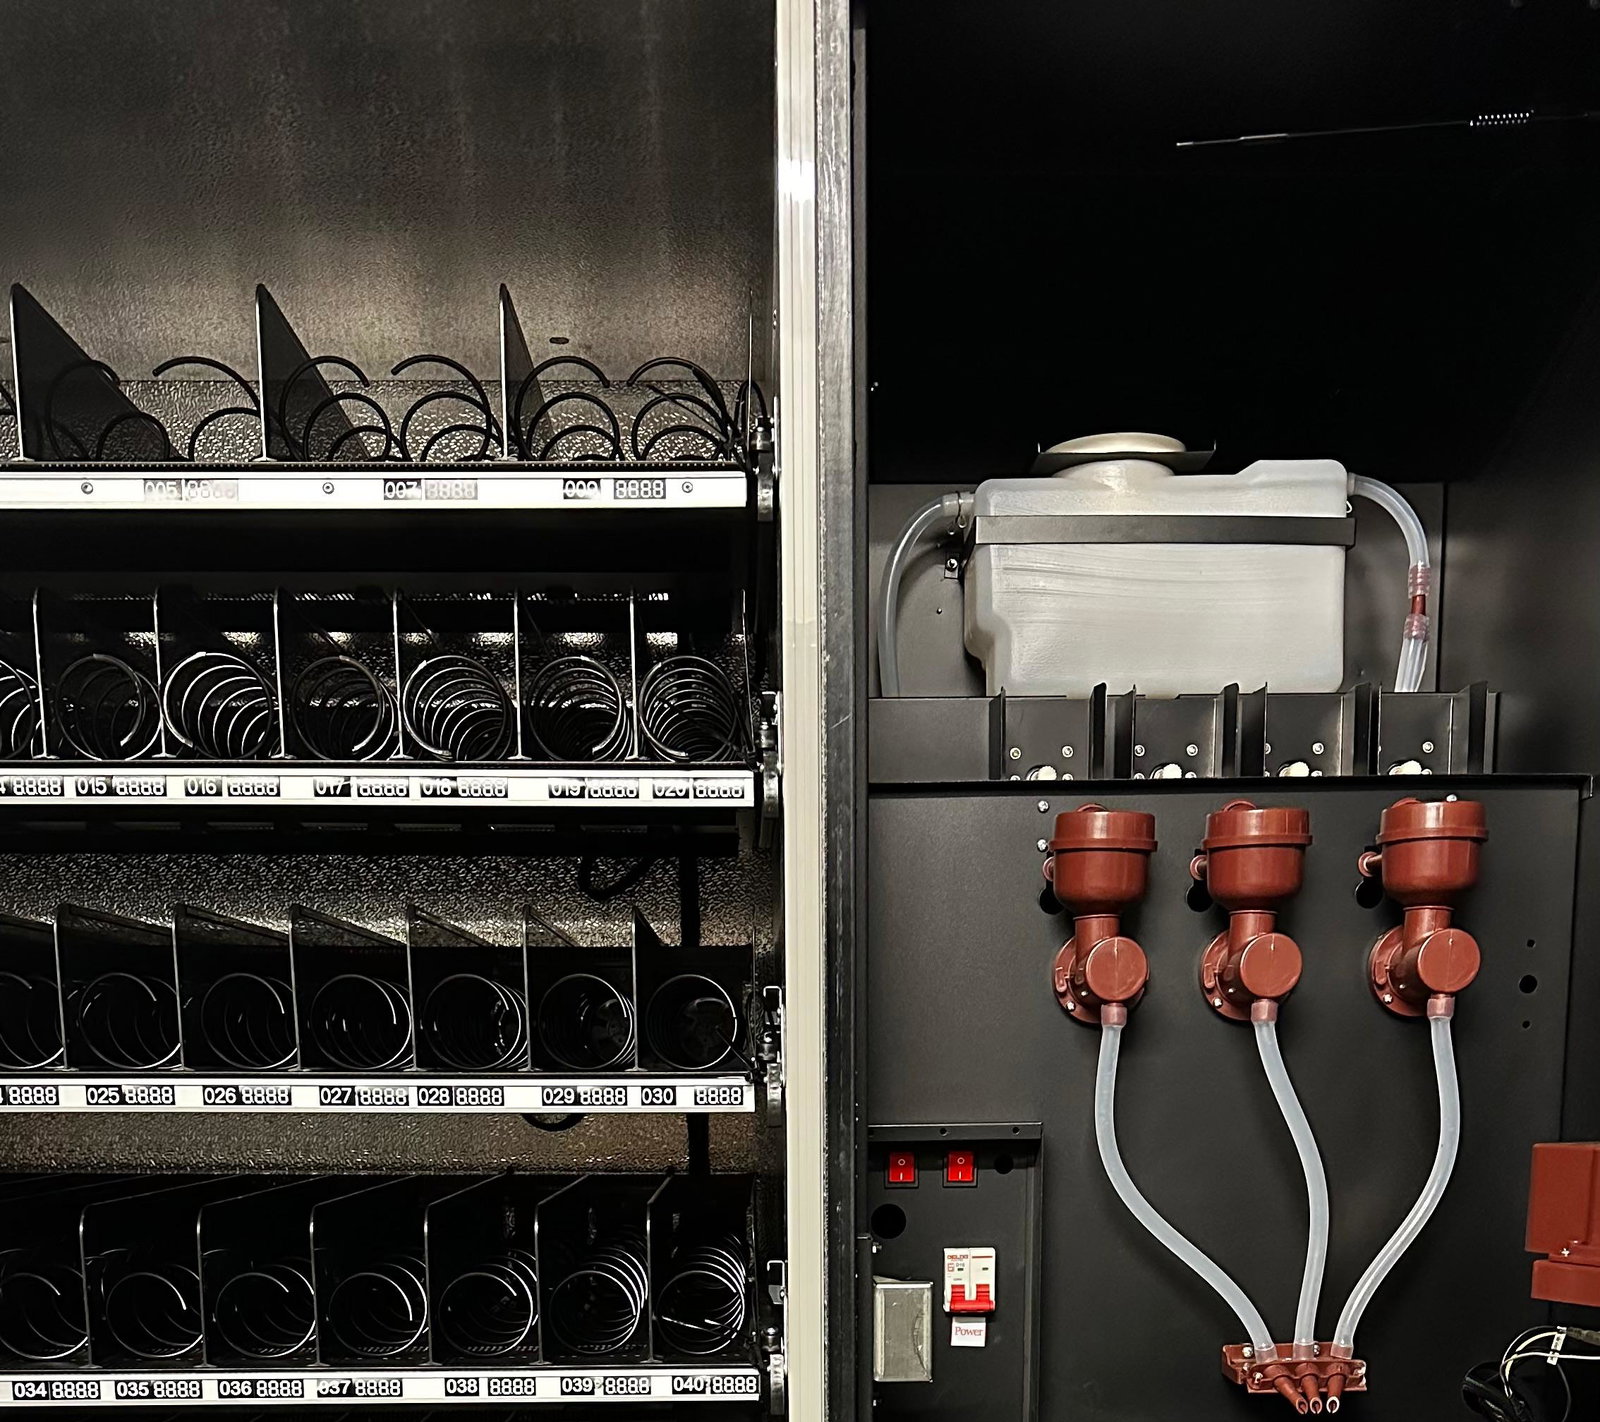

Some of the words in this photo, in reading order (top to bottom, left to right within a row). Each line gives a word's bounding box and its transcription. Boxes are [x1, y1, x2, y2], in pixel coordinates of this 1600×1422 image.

[77, 777, 108, 794] 015
[187, 777, 217, 794] 016
[87, 1087, 120, 1104] 025
[204, 1087, 237, 1103] 026
[320, 1087, 352, 1103] 027
[418, 1087, 450, 1104] 028
[542, 1088, 575, 1104] 029
[641, 1088, 674, 1104] 030
[955, 1327, 983, 1336] Power
[14, 1382, 47, 1398] 034
[117, 1382, 149, 1397] 035
[219, 1381, 252, 1396] 036
[319, 1380, 351, 1396] 037
[446, 1379, 478, 1394] 038
[562, 1377, 593, 1392] 039
[674, 1377, 705, 1391] 040
